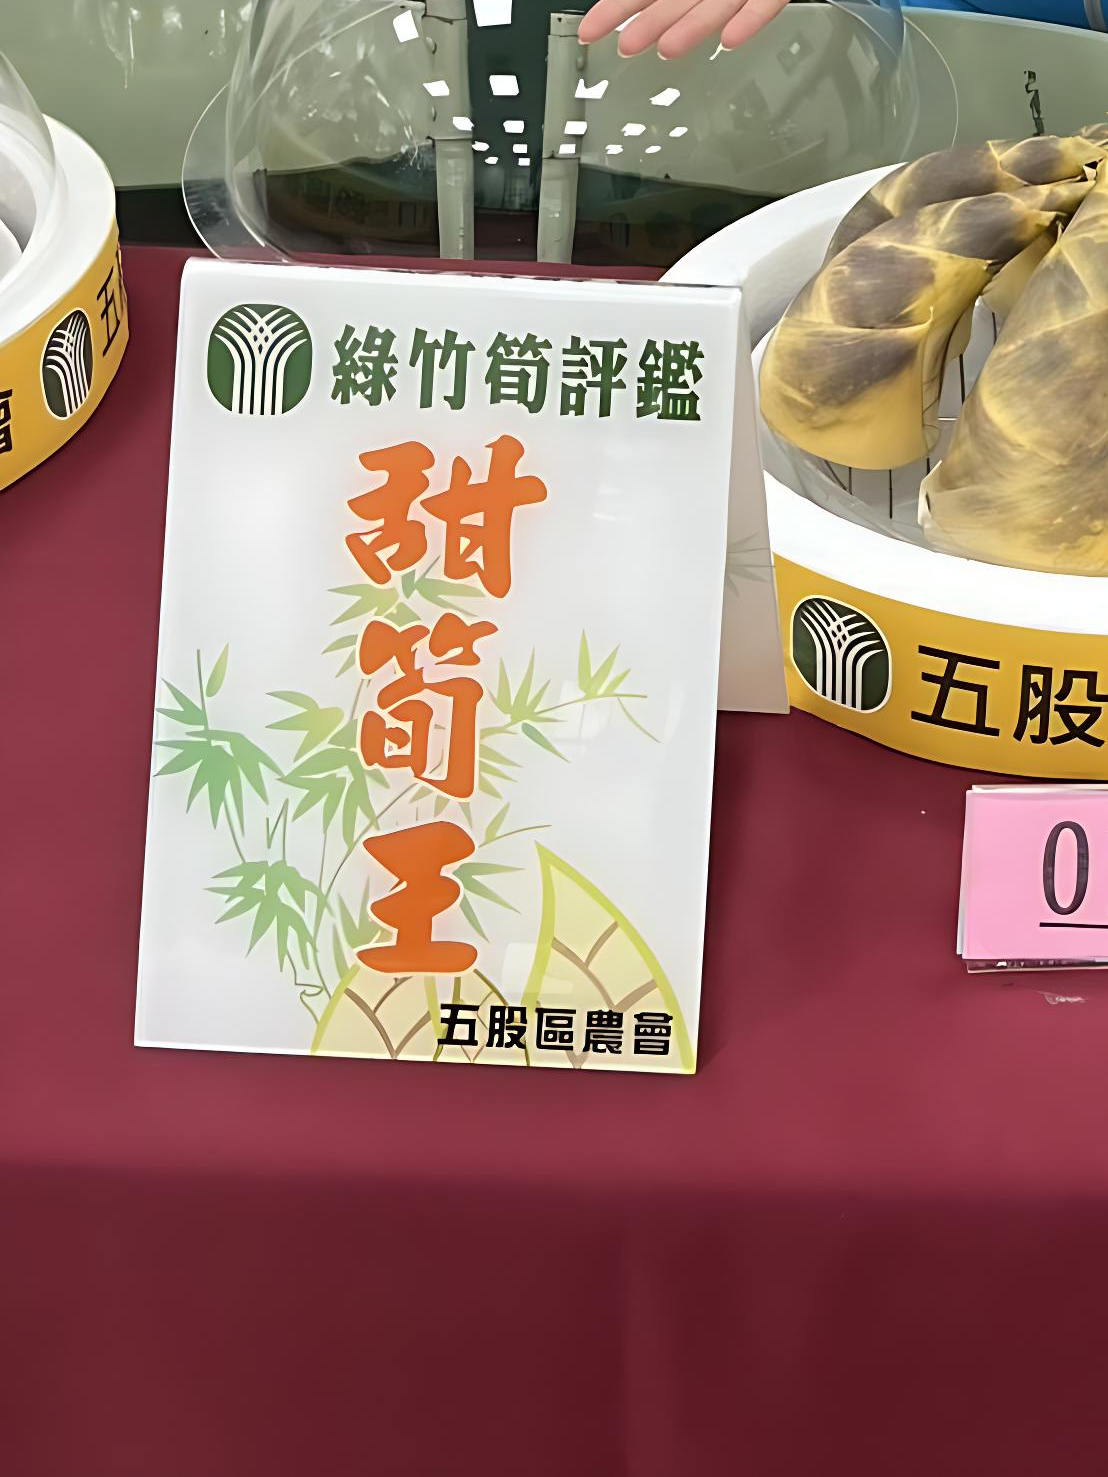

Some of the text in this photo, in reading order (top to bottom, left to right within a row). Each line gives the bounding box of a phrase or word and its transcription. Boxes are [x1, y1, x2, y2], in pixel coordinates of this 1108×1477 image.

[331, 324, 705, 422] 綠竹筍評鑑
[346, 434, 548, 974] 甜筍王
[437, 1004, 674, 1056] 五股區農會
